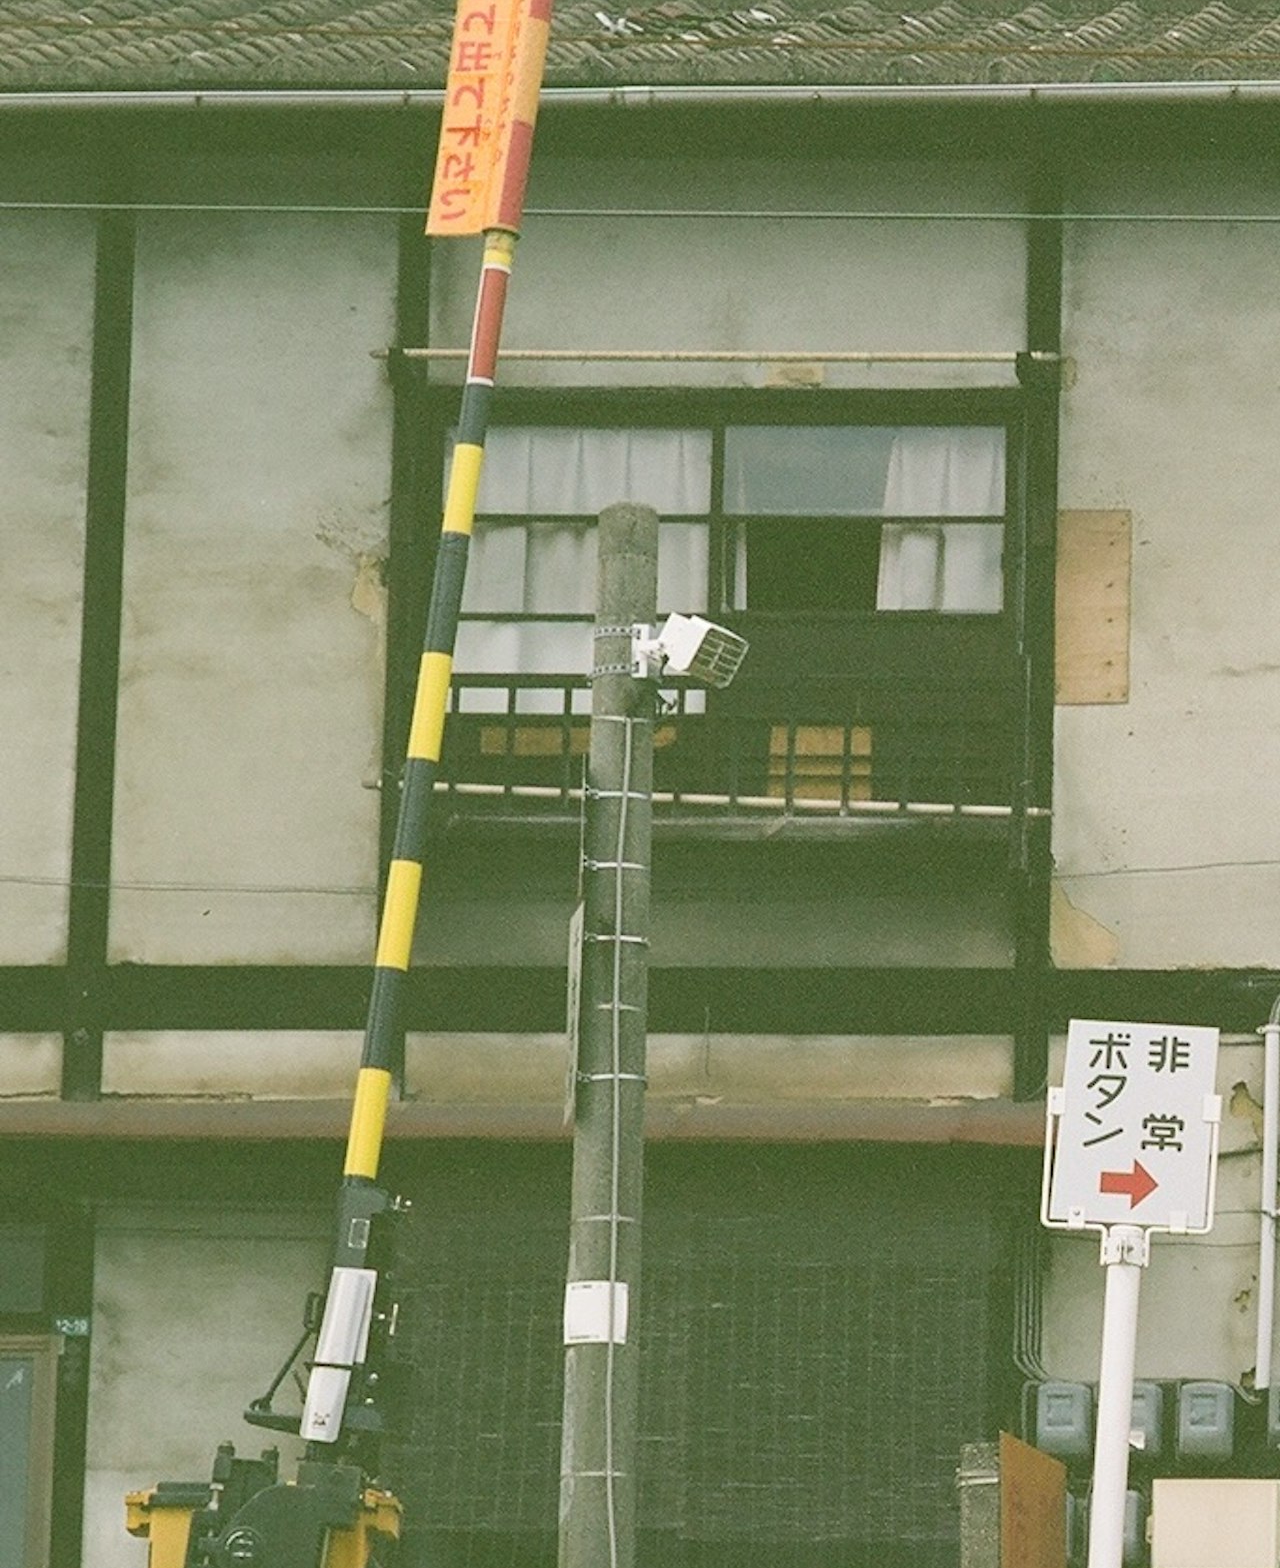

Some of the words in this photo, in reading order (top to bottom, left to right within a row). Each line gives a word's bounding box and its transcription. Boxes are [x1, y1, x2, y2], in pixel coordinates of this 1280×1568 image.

[1082, 1032, 1131, 1148] ボタン
[1141, 1035, 1191, 1153] 非常
